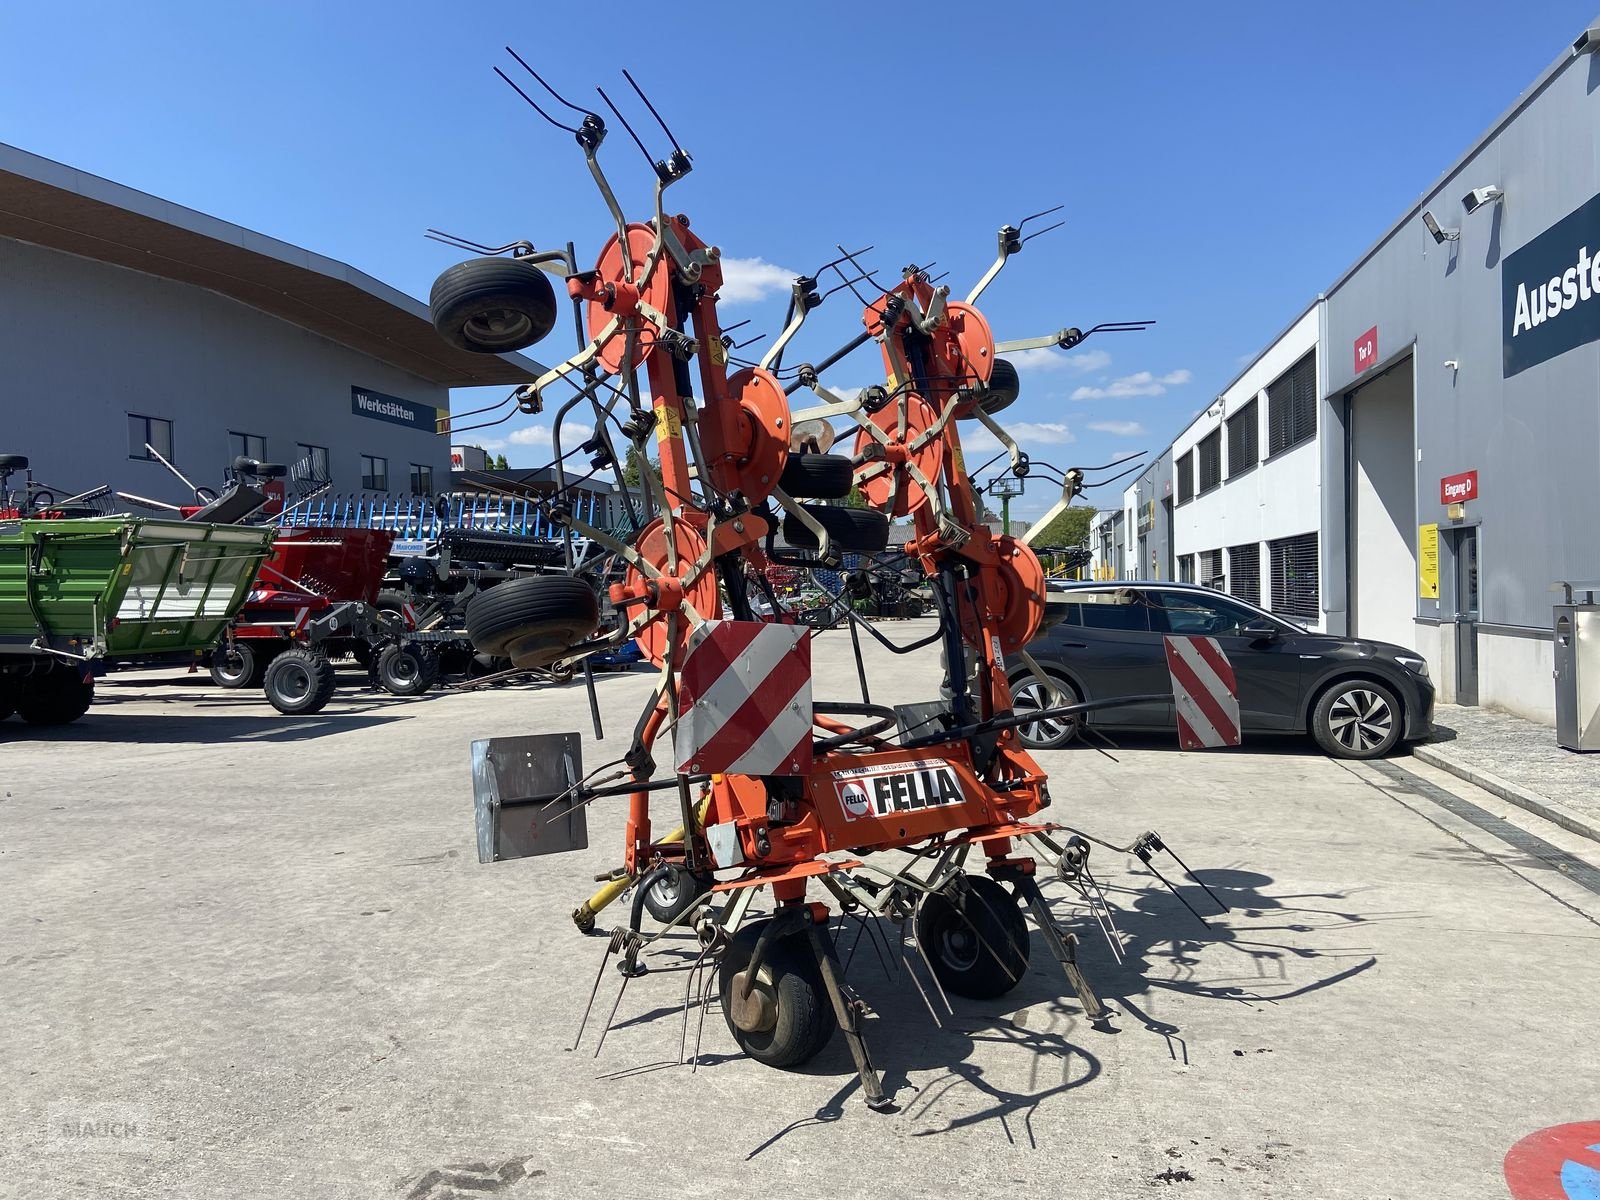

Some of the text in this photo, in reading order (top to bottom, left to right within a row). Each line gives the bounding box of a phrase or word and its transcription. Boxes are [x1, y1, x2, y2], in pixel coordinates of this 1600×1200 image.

[1358, 340, 1372, 362] Tor D
[357, 394, 415, 421] Werkstätten
[1445, 479, 1471, 497] Eingang D
[845, 793, 867, 805] FELLA
[873, 768, 963, 815] FELLA
